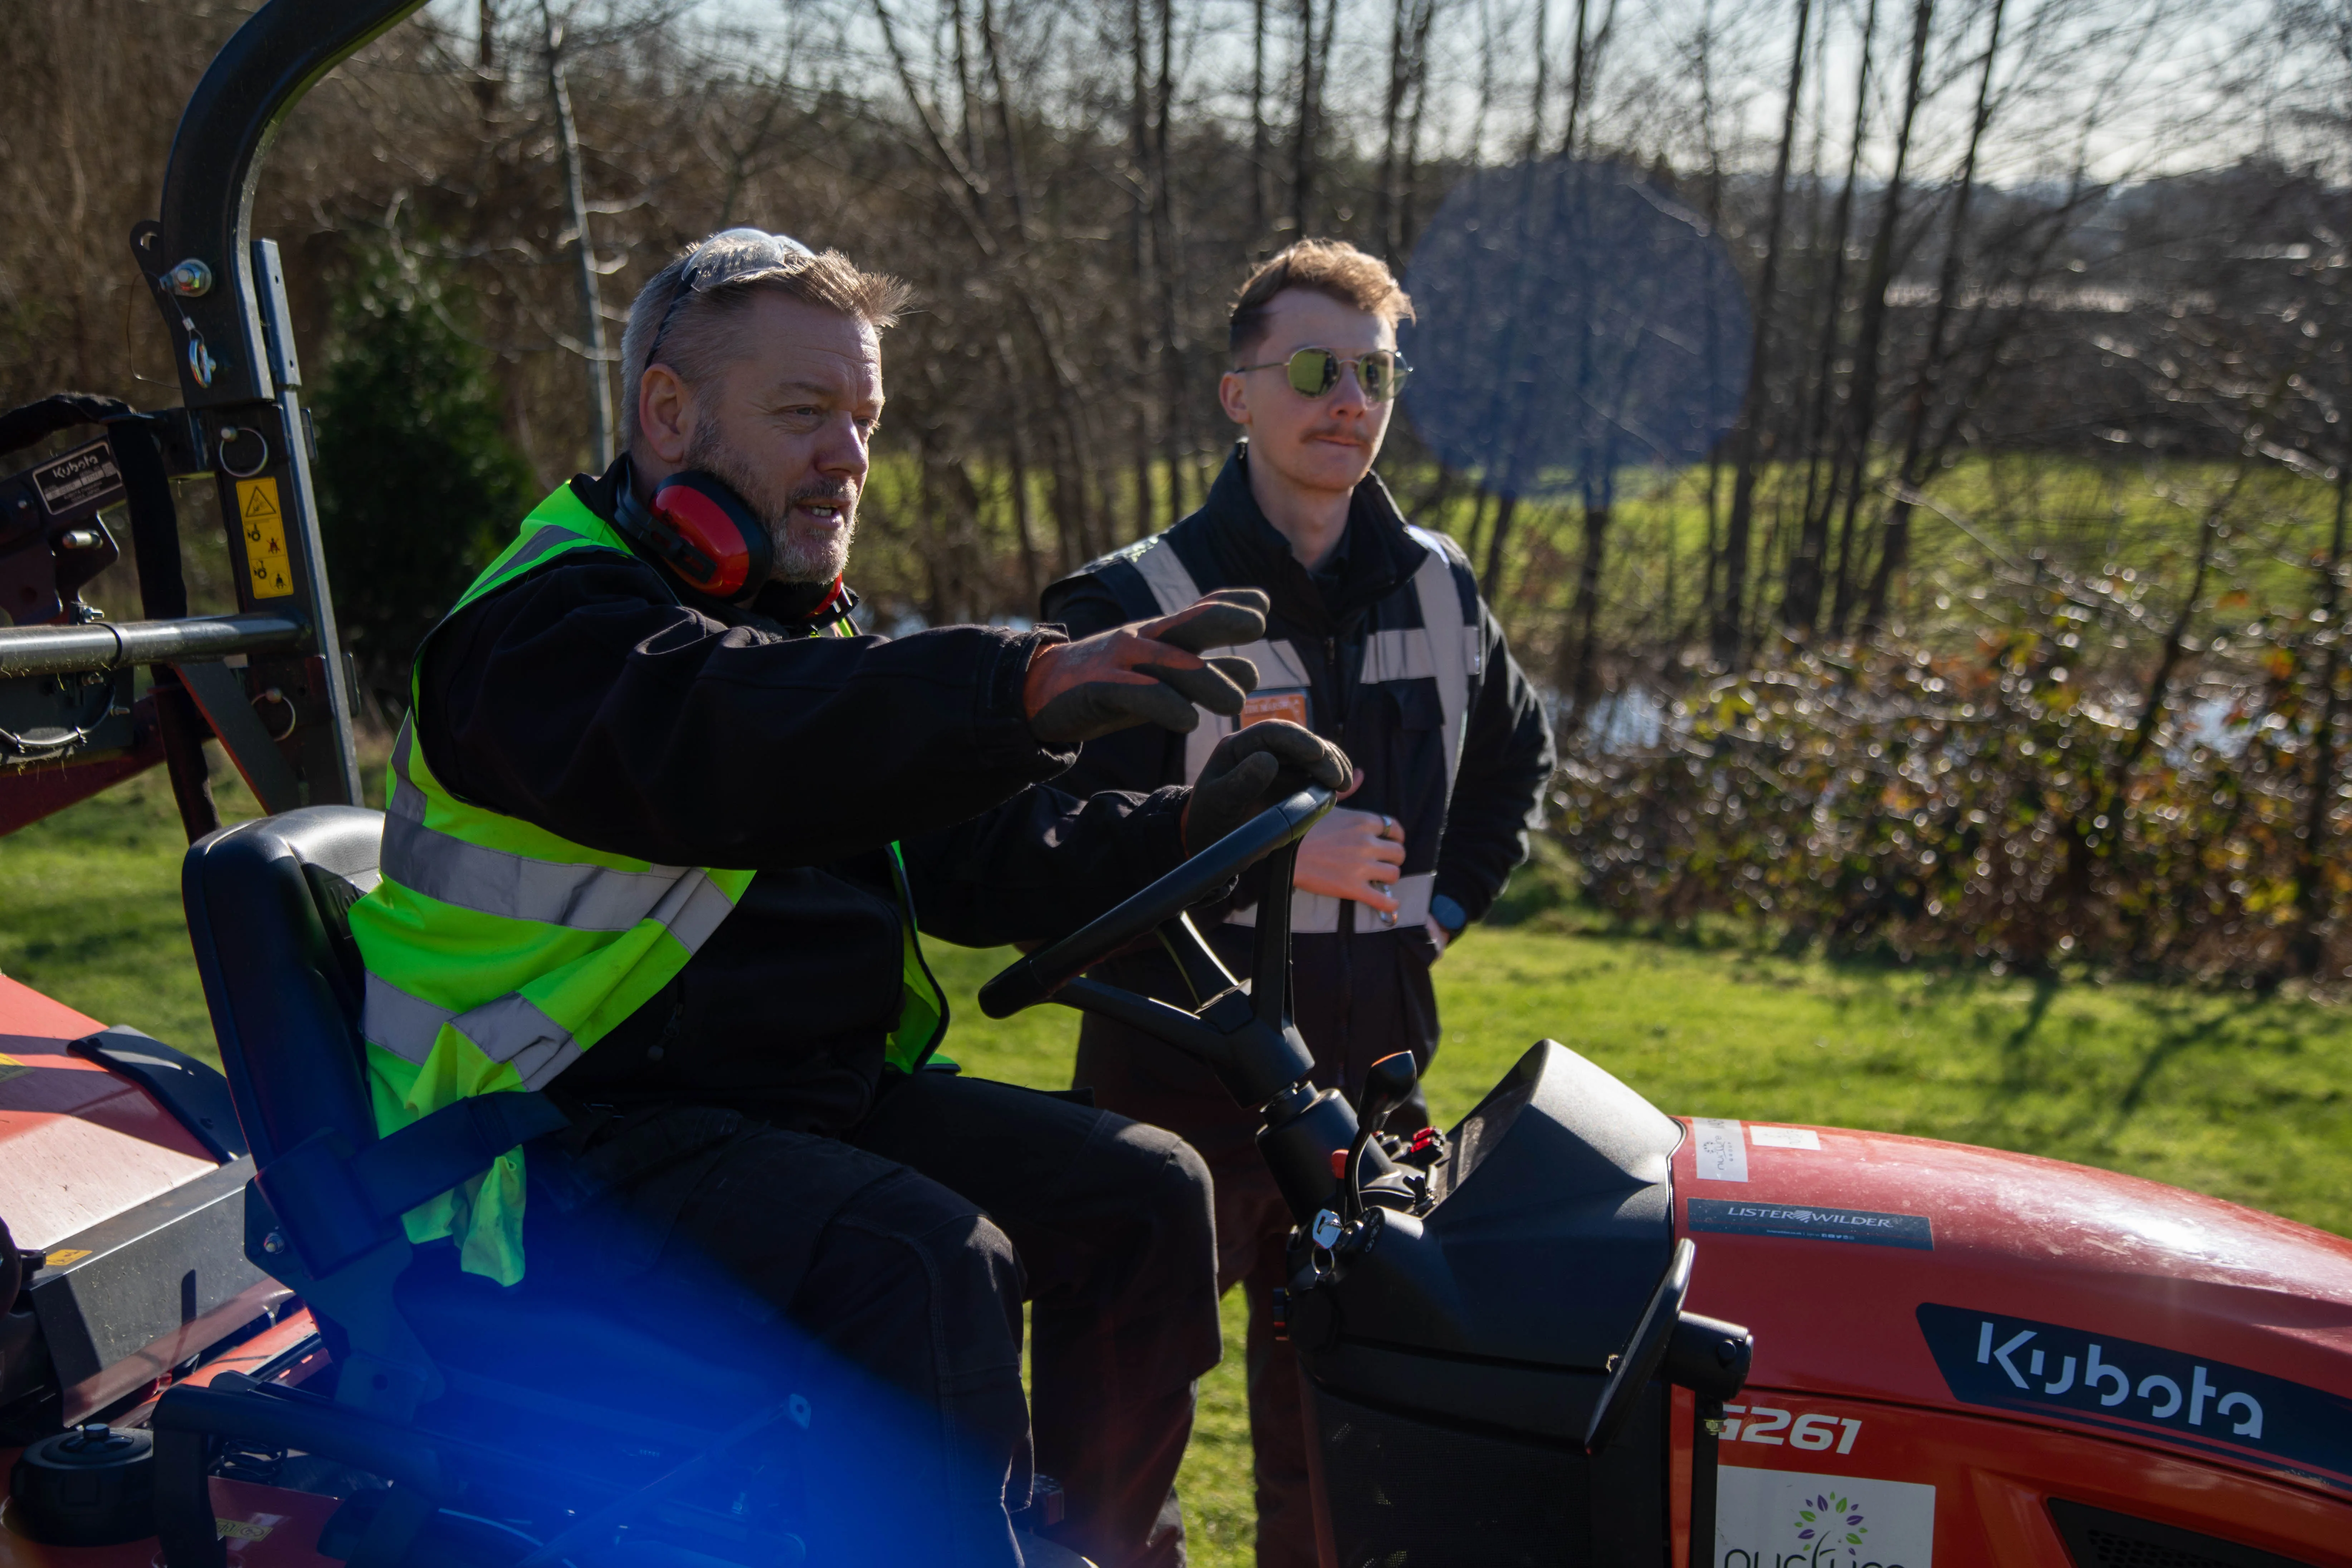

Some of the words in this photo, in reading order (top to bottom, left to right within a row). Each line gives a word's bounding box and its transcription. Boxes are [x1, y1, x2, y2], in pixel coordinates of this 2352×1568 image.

[52, 455, 99, 478] Kubota
[1727, 1207, 1793, 1220] LISTER
[1811, 1213, 1894, 1228] WILDER
[1977, 1321, 2263, 1439] Kubota
[1724, 1530, 1905, 1568] nurt
